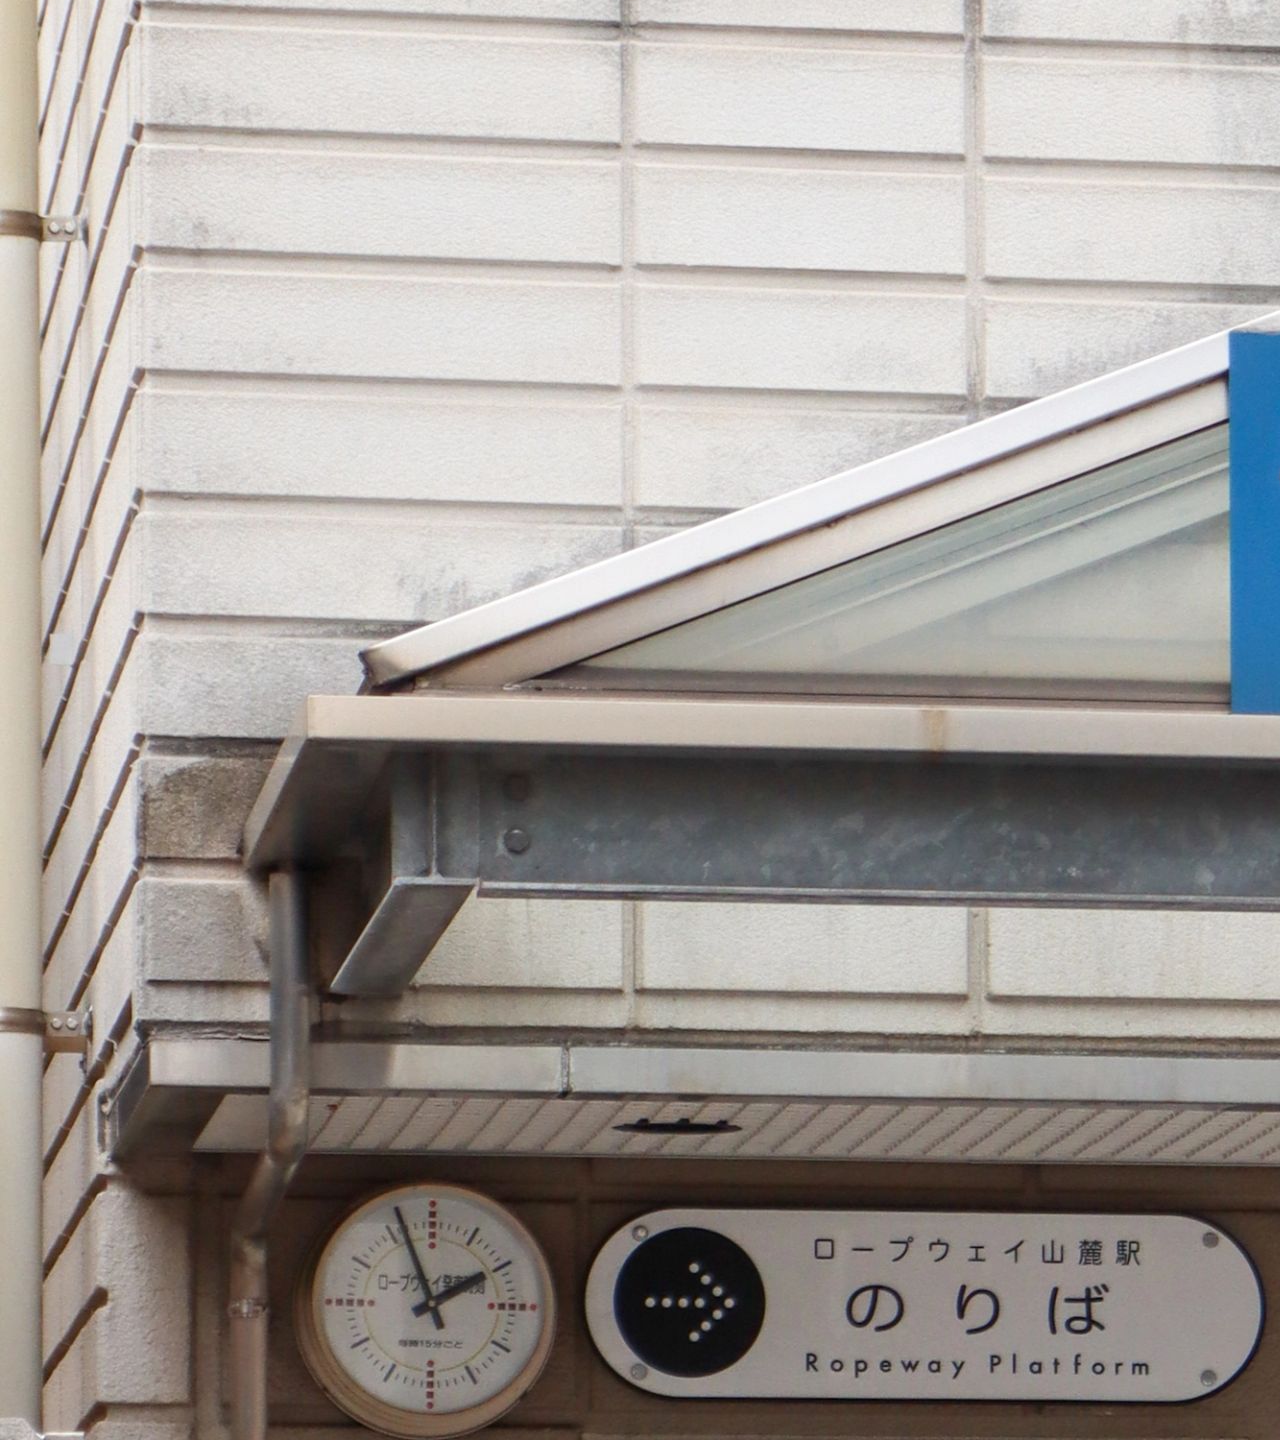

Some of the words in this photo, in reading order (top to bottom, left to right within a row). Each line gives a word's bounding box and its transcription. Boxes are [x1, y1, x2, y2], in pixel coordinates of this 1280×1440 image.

[813, 1238, 1143, 1267] ロープウェイ山麓駅
[845, 1281, 1111, 1336] のりば
[804, 1352, 965, 1380] Ropeway
[989, 1354, 1151, 1377] Platform
